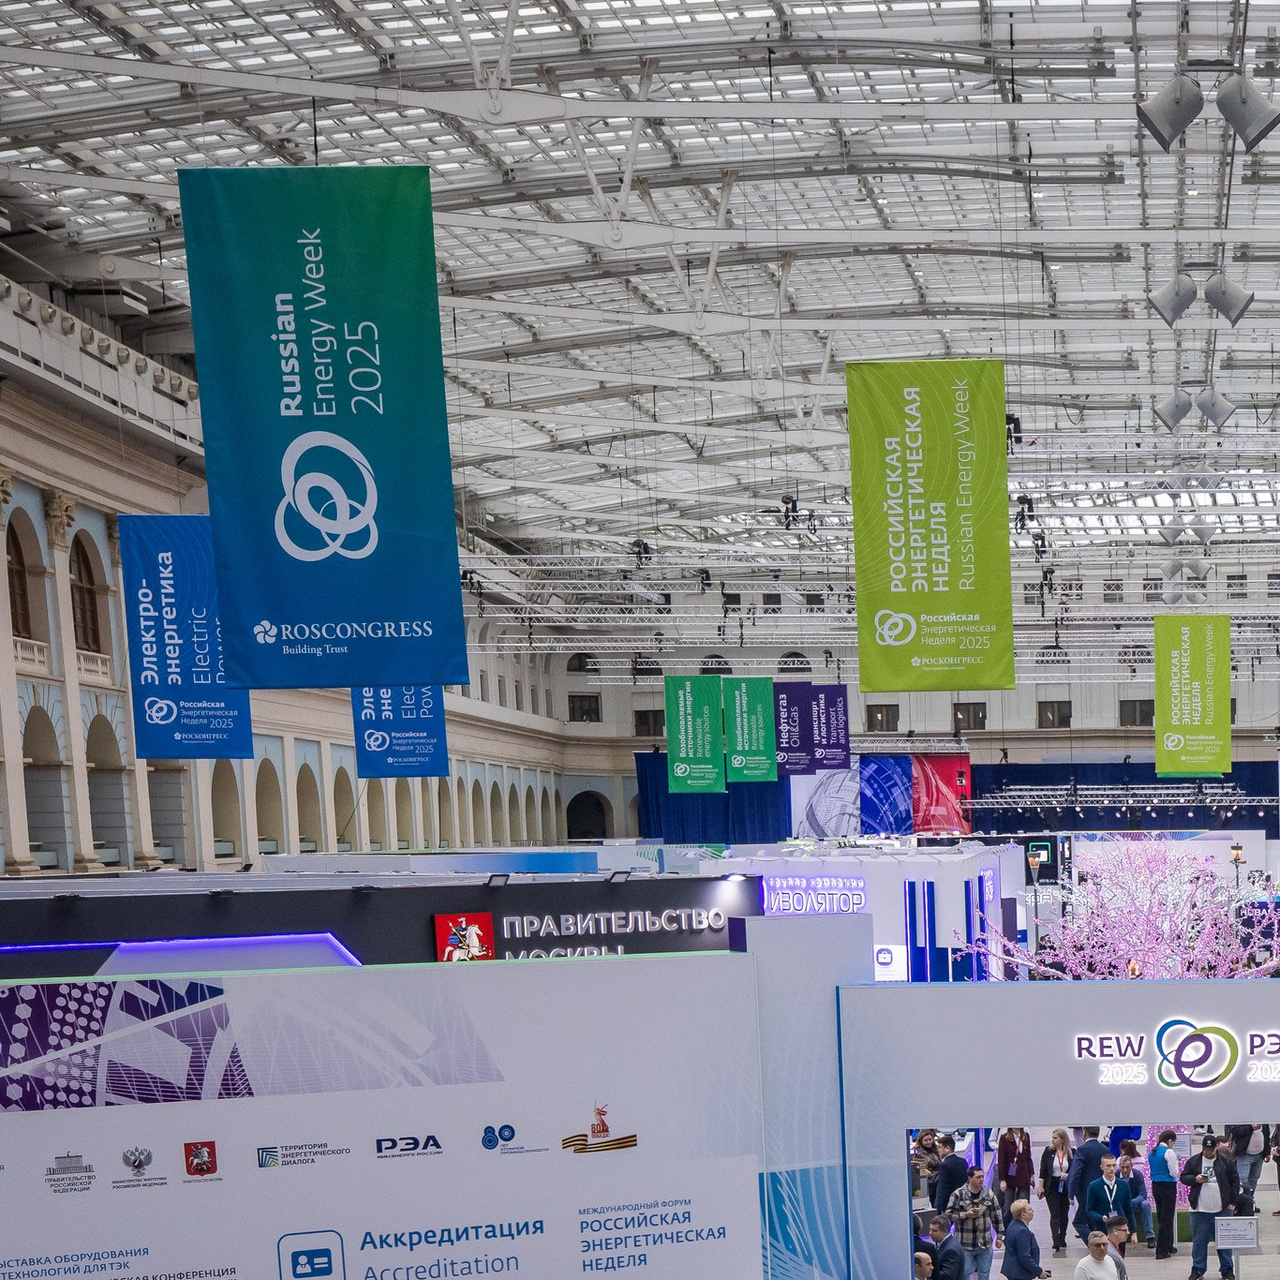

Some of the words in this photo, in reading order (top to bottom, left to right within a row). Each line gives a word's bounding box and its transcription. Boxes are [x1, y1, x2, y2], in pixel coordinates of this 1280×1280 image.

[297, 227, 325, 313] Week
[272, 292, 302, 417] Russian
[306, 318, 338, 417] Energy
[343, 320, 384, 415] 2025
[951, 378, 969, 437] Week
[955, 440, 976, 507] Energy
[904, 387, 928, 593] ЭНЕРГЕТИЧЕСКАЯ
[884, 437, 907, 593] РОССИЙСКАЯ
[929, 502, 951, 592] НЕДЕЛЯ
[957, 517, 975, 590] Russian
[138, 578, 159, 685] Электро-
[158, 551, 183, 685] энергетика
[280, 620, 433, 642] ROSCONGRESS
[921, 613, 980, 623] Российская
[921, 624, 996, 634] Энергетическая
[188, 607, 211, 684] Electric
[282, 644, 322, 656] Building
[324, 644, 349, 655] Trust
[921, 636, 956, 646] Неделя
[959, 636, 990, 649] 2025
[1205, 624, 1213, 651] Week
[922, 656, 983, 665] РОСКОНГРЕСС
[1205, 653, 1216, 684] Energy
[1170, 650, 1180, 725] РОССИЙСКАЯ
[1181, 627, 1190, 725] ЭНЕРГЕТИЧЕСКАЯ
[180, 709, 238, 717] Энергетическая
[1192, 681, 1202, 725] НЕДЕЛЯ
[1205, 687, 1214, 725] Russian
[181, 717, 207, 725] Неделя
[209, 719, 234, 729] 2025
[779, 694, 791, 747] Нефтегаз
[790, 707, 800, 747] Oil&Gas
[769, 892, 864, 912] ИЗОЛЯТОР
[502, 908, 726, 939] ПРАВИТЕЛЬСТВО
[1077, 1036, 1145, 1058] REW
[1100, 1064, 1146, 1083] 2025
[280, 1143, 328, 1151] ТЕРРИТОРИЯ
[281, 1148, 350, 1159] ЭНЕРГЕТИЧЕСКОГО
[376, 1135, 442, 1153] РЭА
[281, 1158, 315, 1166] ДИАЛОГА
[579, 1201, 659, 1215] МЕЖДУНАРОДНЫЙ
[661, 1199, 691, 1207] ФОРУМ
[360, 1220, 545, 1252] Аккредитация
[580, 1211, 691, 1233] РОССИЙСКАЯ
[581, 1227, 726, 1252] ЭНЕРГЕТИЧЕСКАЯ
[54, 1248, 149, 1263] ОБОРУДОВАНИЯ
[582, 1254, 647, 1272] НЕДЕЛЯ
[1, 1264, 81, 1280] ТЕХНОЛОГИЙ
[83, 1263, 107, 1274] ДЛЯ
[109, 1261, 130, 1270] ТЭК
